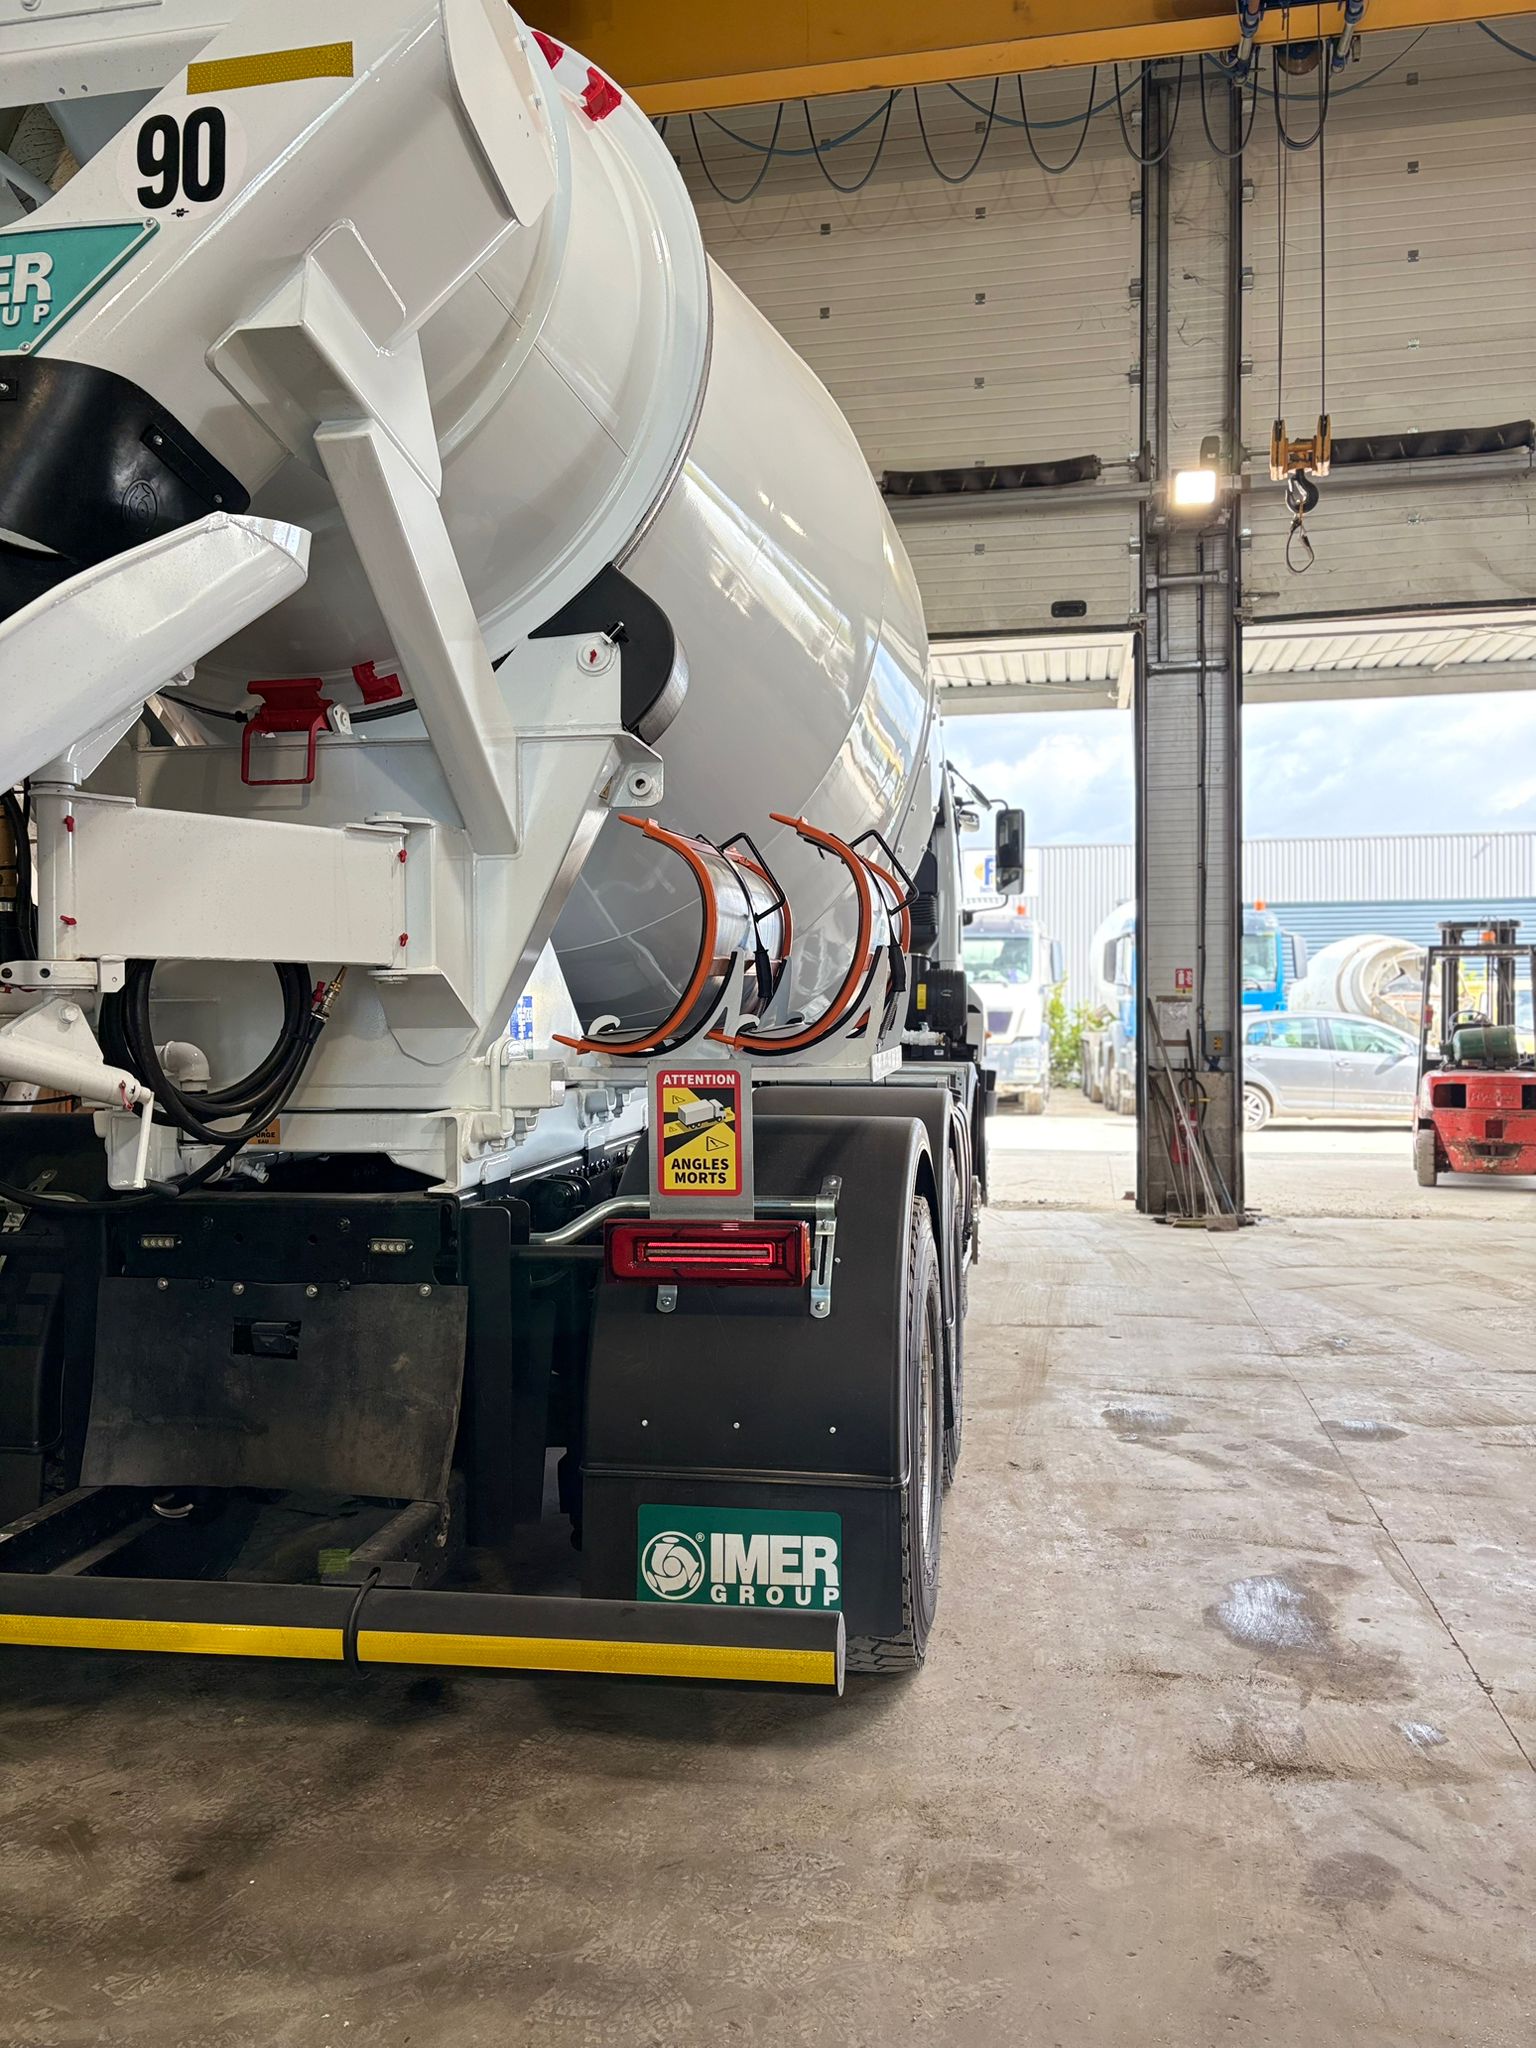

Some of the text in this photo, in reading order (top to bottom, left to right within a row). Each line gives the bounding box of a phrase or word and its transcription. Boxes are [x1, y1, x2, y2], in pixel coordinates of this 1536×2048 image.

[136, 106, 226, 209] 90
[663, 1074, 735, 1085] ATTENTION
[671, 1158, 729, 1170] ANGLES
[674, 1172, 727, 1184] MORTS
[710, 1532, 840, 1586] IMER
[710, 1584, 840, 1606] GROUP
